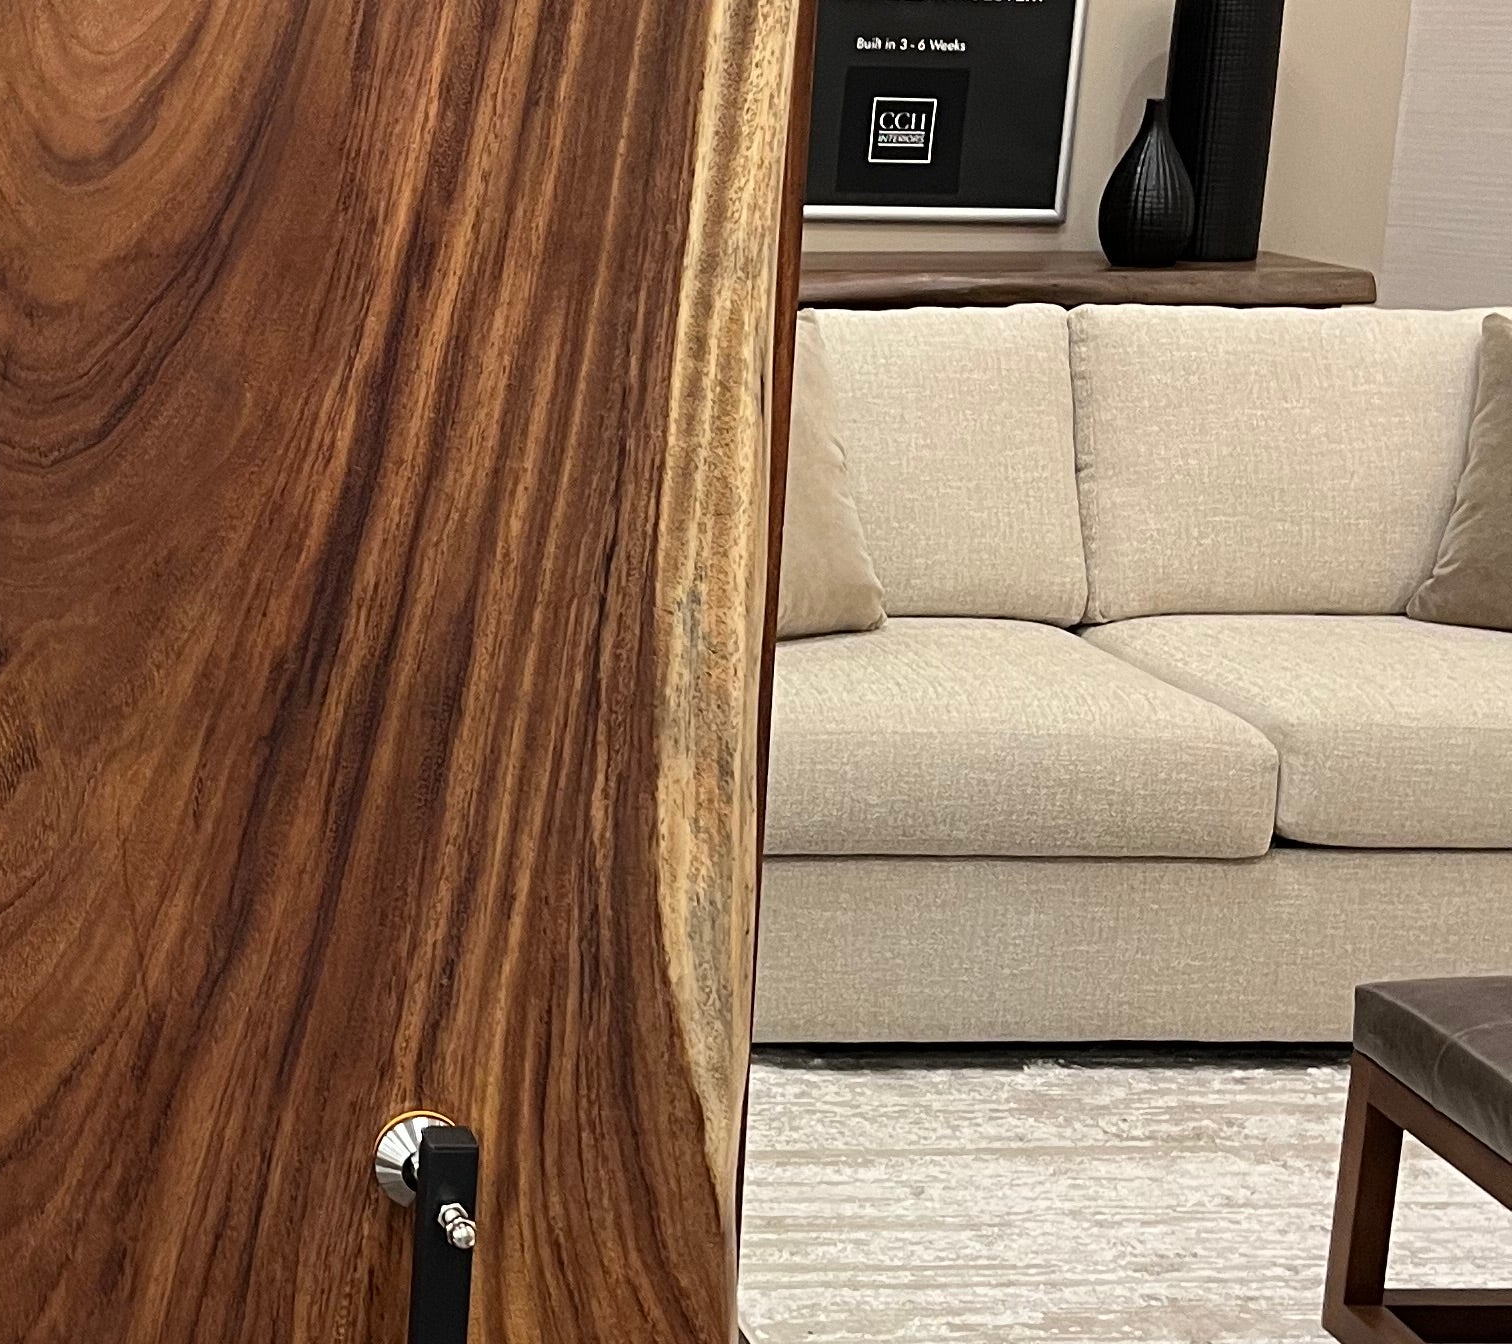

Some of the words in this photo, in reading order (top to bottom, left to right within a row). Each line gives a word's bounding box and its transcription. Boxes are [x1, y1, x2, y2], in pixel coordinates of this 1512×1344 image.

[856, 37, 881, 50] Built
[885, 38, 895, 50] in
[899, 38, 908, 51] 3
[917, 38, 926, 51] 6
[929, 38, 966, 52] Weeks
